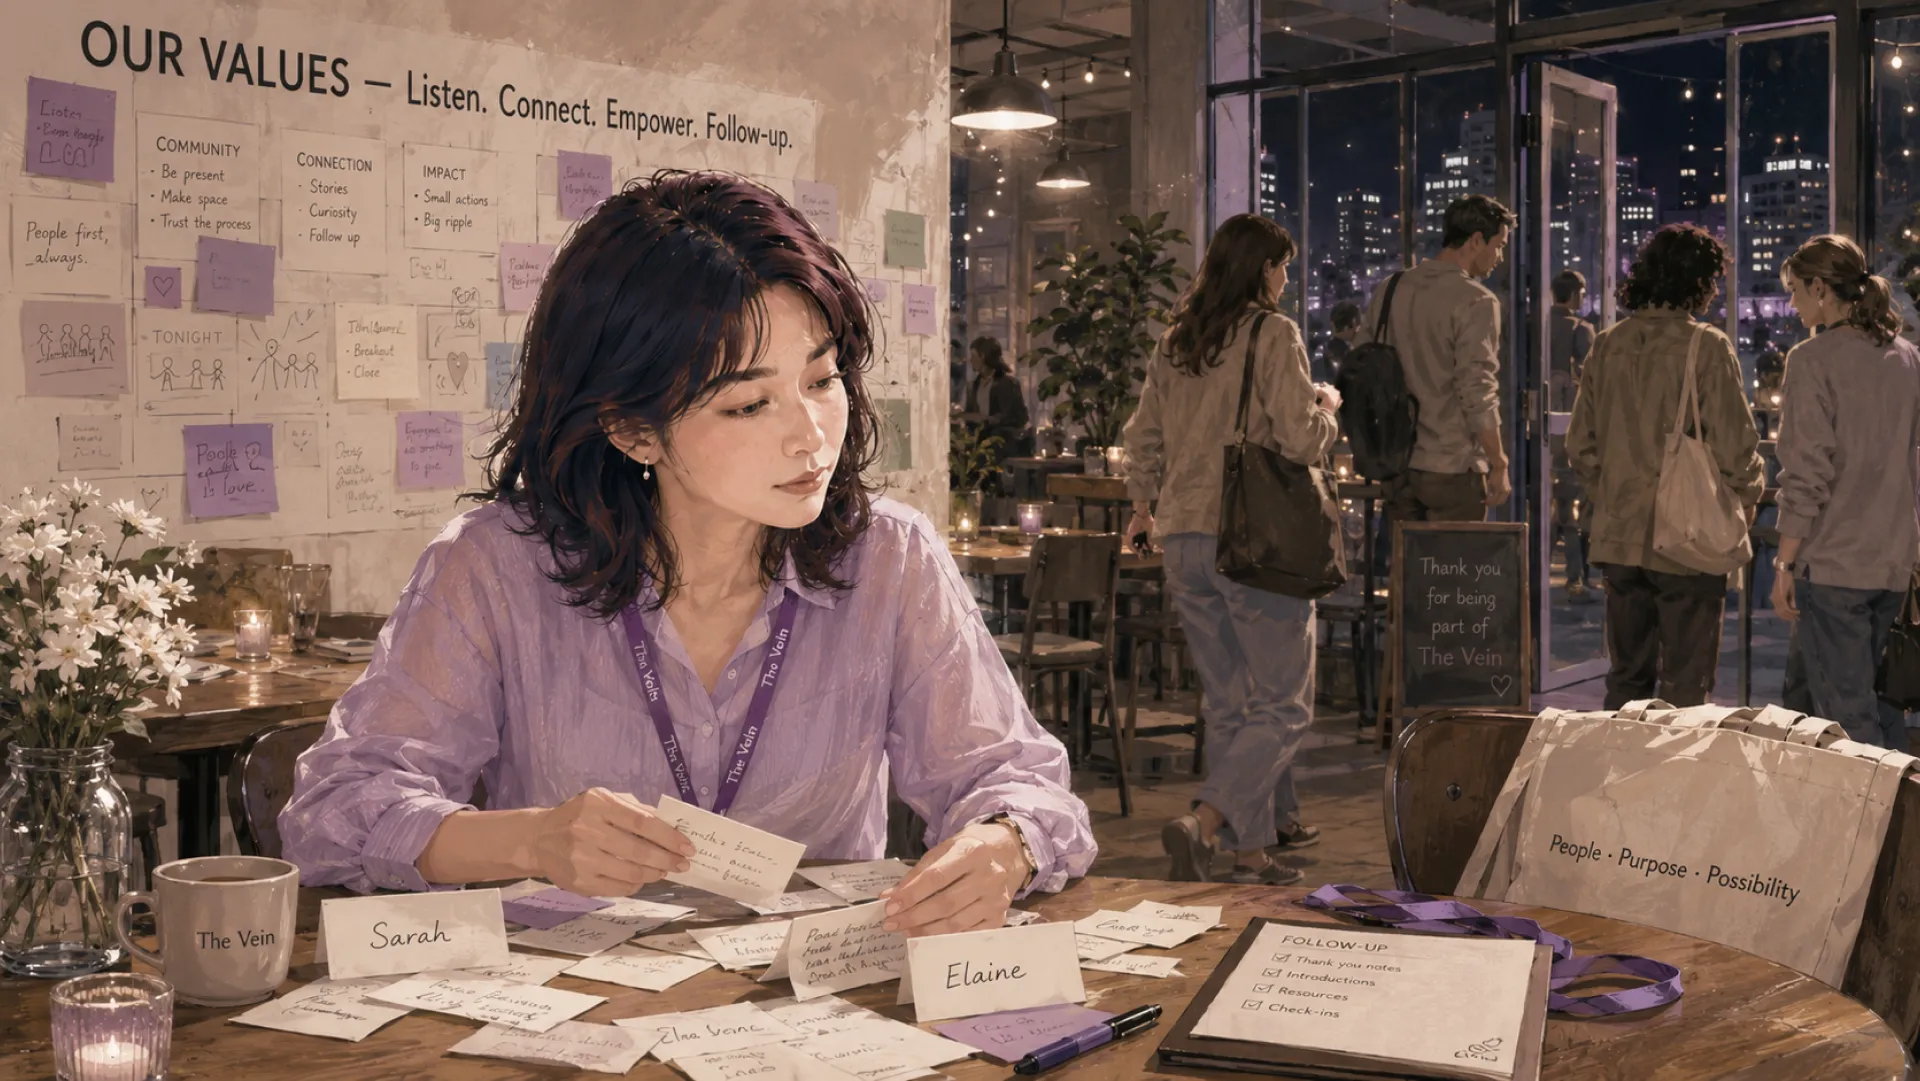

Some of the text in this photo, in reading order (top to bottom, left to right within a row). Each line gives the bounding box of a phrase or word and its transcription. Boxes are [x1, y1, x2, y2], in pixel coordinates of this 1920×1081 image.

[81, 19, 184, 76] OUR
[200, 38, 350, 97] VALUES
[407, 70, 488, 114] Listen.
[499, 83, 597, 127] Connect.
[606, 98, 698, 140] Empower.
[707, 112, 793, 156] Follow-up.
[156, 136, 241, 157] COMMUNITY
[297, 152, 373, 172] CONNECTION
[162, 163, 225, 185] Be present
[423, 165, 466, 181] IMPACT
[310, 178, 348, 195] Stories
[161, 189, 229, 210] Make space
[424, 189, 488, 207] Small actions
[160, 213, 252, 234] Trust the process
[309, 203, 357, 225] Curiosity
[424, 212, 473, 232] Big ripple
[26, 220, 109, 246] People first,
[309, 229, 361, 248] Follow up
[152, 330, 222, 344] TONIGHT
[1419, 556, 1501, 582] Thank you
[1426, 586, 1496, 611] for being
[1432, 617, 1491, 641] part of
[1418, 647, 1502, 666] The Vein
[1549, 834, 1800, 907] People Purpose Possibility
[196, 930, 275, 950] The Vein
[369, 919, 451, 950] Sarah
[1282, 935, 1388, 952] FOLLOW-UP
[1296, 956, 1402, 973] Thank you notes
[945, 961, 1027, 990] Elaine
[1286, 971, 1376, 988] Introductions
[1278, 986, 1349, 1002] Resources
[1268, 1003, 1340, 1019] Check-ins
